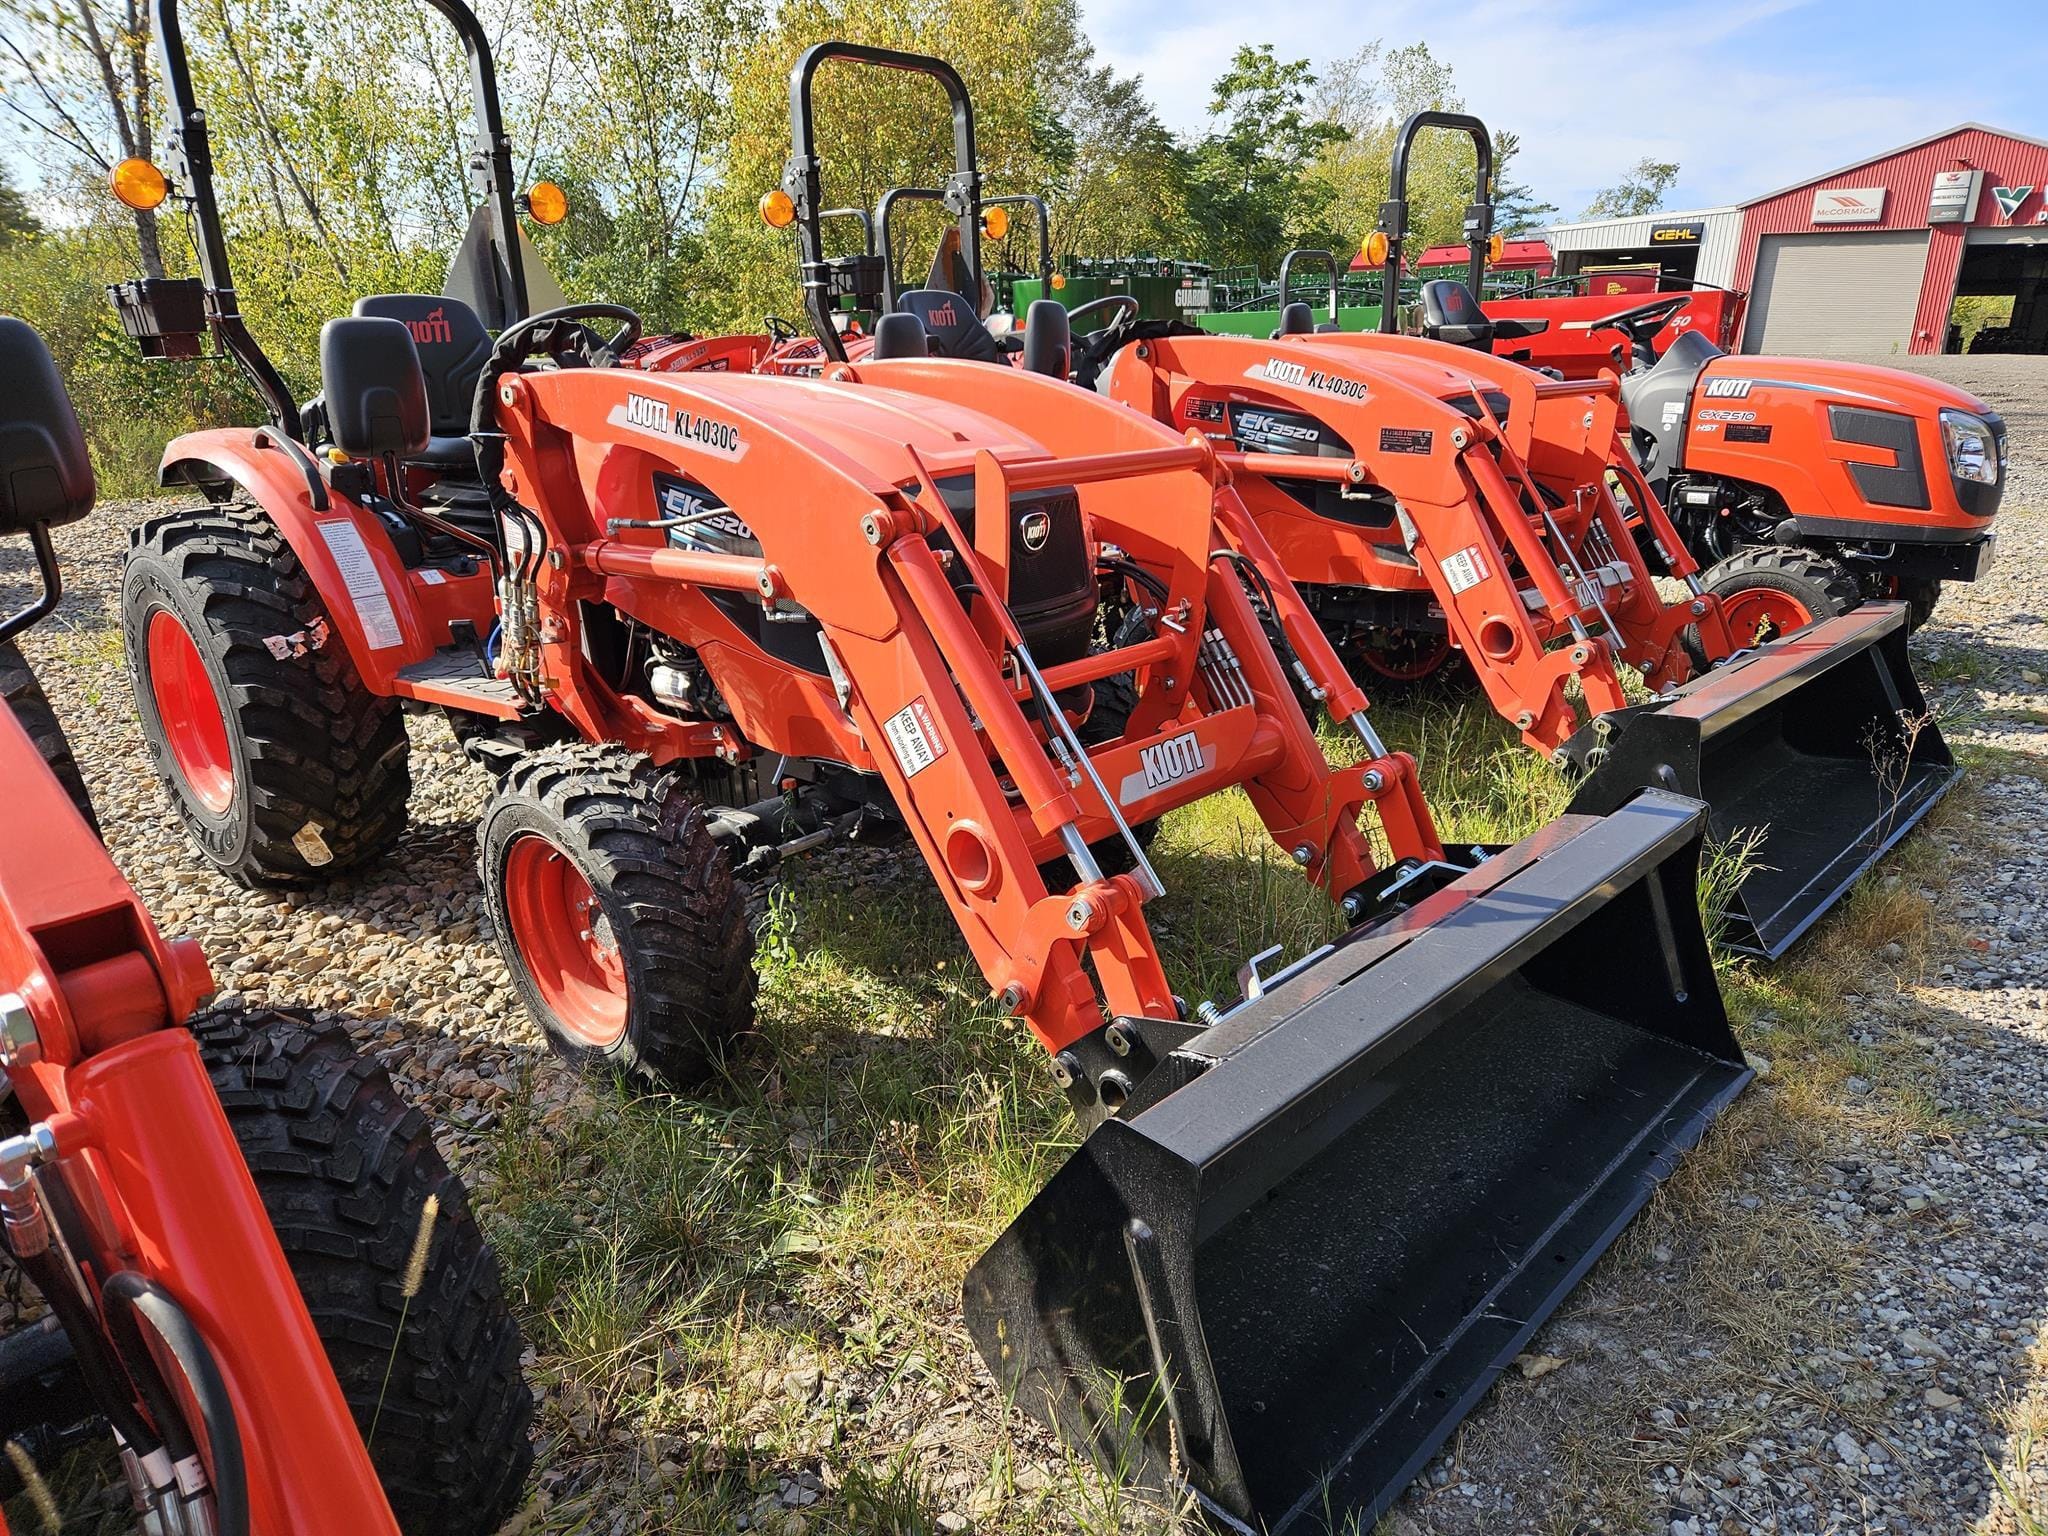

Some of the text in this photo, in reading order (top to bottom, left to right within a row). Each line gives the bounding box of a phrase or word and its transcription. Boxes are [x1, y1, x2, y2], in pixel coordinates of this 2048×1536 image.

[1817, 207, 1877, 216] McCORMICK
[1654, 229, 1697, 240] GEHL
[928, 309, 957, 327] KIOTI
[405, 320, 452, 344] IOTI
[1264, 357, 1367, 400] KIOTI KL4030C
[1704, 378, 1753, 399] KIOTI
[627, 392, 738, 452] KIOTI KL4030C
[1244, 429, 1269, 443] SE
[1027, 525, 1047, 540] KIOTI
[889, 720, 899, 735] from
[895, 734, 911, 760] working
[899, 710, 930, 764] KEEP AWAY
[921, 713, 944, 755] WARNING
[1139, 729, 1205, 790] KIOTI
